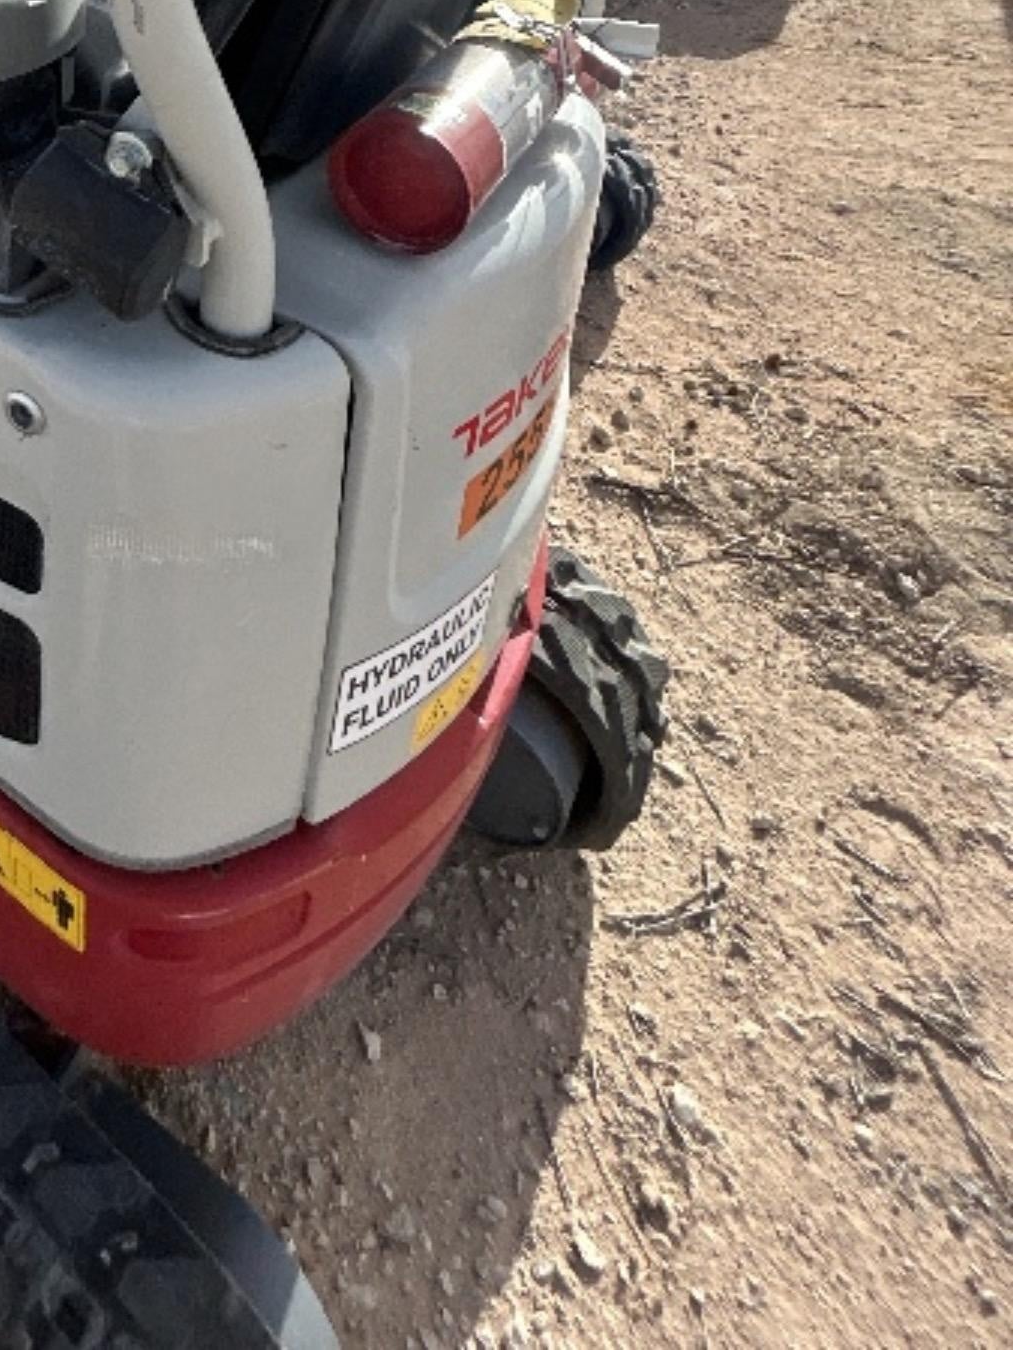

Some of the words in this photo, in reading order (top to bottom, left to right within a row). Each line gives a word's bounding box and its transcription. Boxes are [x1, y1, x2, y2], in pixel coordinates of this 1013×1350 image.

[341, 674, 421, 738] FLUID
[427, 618, 484, 683] ONLY
[347, 585, 491, 701] HYDRAULIC
